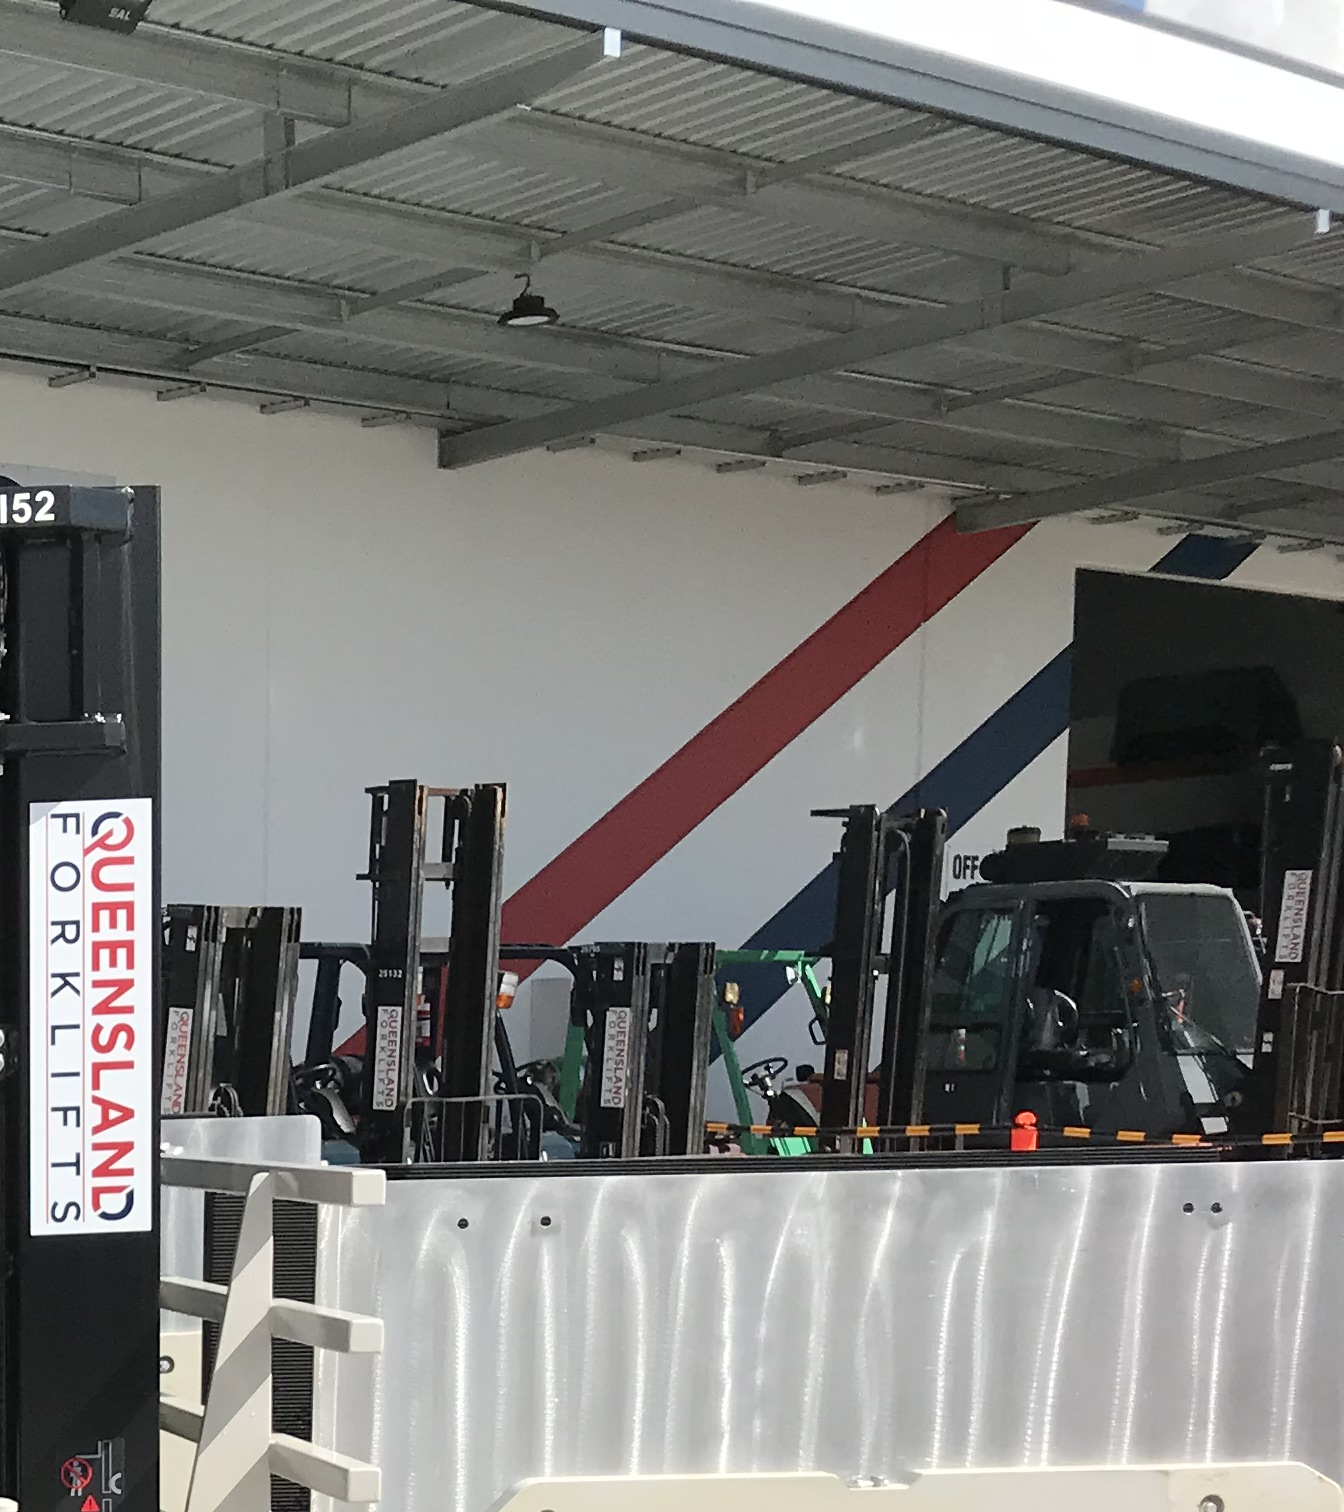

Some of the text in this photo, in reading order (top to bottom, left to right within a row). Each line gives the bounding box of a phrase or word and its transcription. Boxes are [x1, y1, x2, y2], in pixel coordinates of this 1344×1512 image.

[952, 853, 979, 880] OFF
[50, 813, 81, 1223] FORKLIFTS
[84, 811, 135, 1222] QUEENSLAND
[171, 1010, 190, 1114] QUEENSLAND
[375, 1008, 389, 1108] FORKLIFTS
[384, 1008, 399, 1108] QUEENSLAND
[612, 1009, 628, 1106] QUEENSLAND
